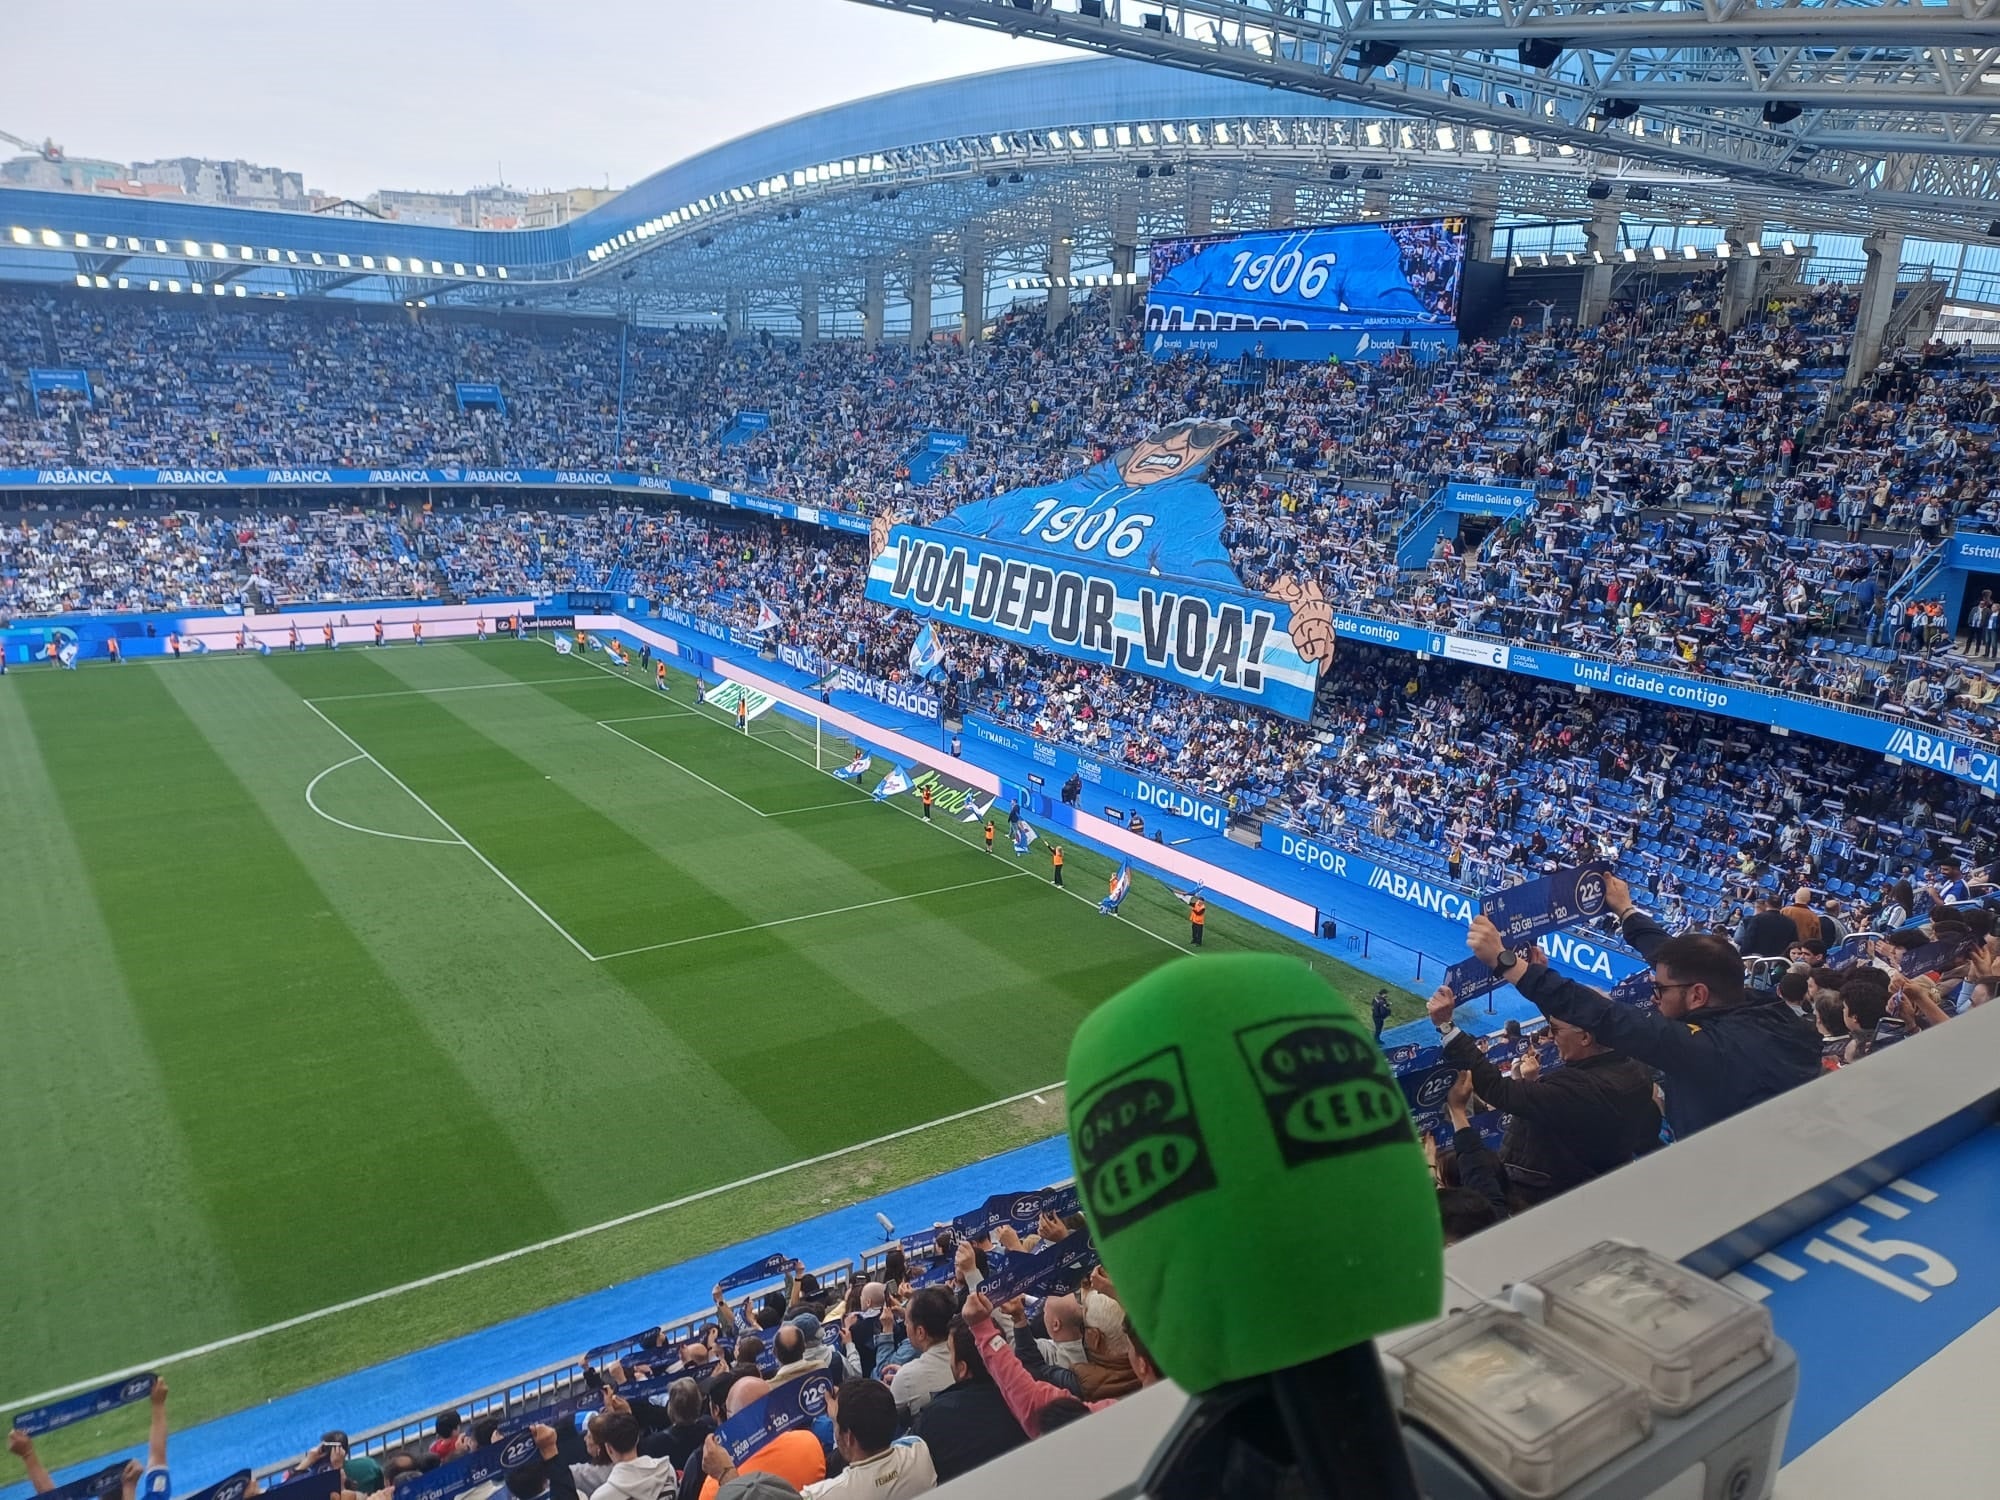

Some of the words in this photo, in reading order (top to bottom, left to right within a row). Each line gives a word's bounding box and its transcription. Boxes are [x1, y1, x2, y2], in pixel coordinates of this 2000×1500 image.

[1227, 251, 1336, 299] 1906
[1456, 491, 1484, 503] Estrella
[1485, 493, 1511, 505] Galicia
[1021, 498, 1154, 558] 1906
[1960, 543, 2000, 559] Estrell
[890, 536, 968, 613] VOA
[970, 554, 1132, 668] DEPOR,
[1138, 589, 1275, 696] VOA!
[1332, 617, 1358, 632] dade
[1360, 625, 1400, 642] contigo
[1614, 673, 1664, 693] cidade
[1668, 684, 1728, 707] contigo
[1137, 780, 1175, 809] DIGI
[1181, 796, 1220, 829] DIGI
[1579, 880, 1602, 903] 22€
[1537, 934, 1613, 980] ANCA
[1271, 1038, 1370, 1075] ONDA
[1082, 1088, 1164, 1151] ONDA
[1302, 1088, 1396, 1133] CERO
[1101, 1141, 1181, 1208] CERO
[1803, 1217, 1958, 1303] 15
[980, 1278, 1001, 1295] DIGI
